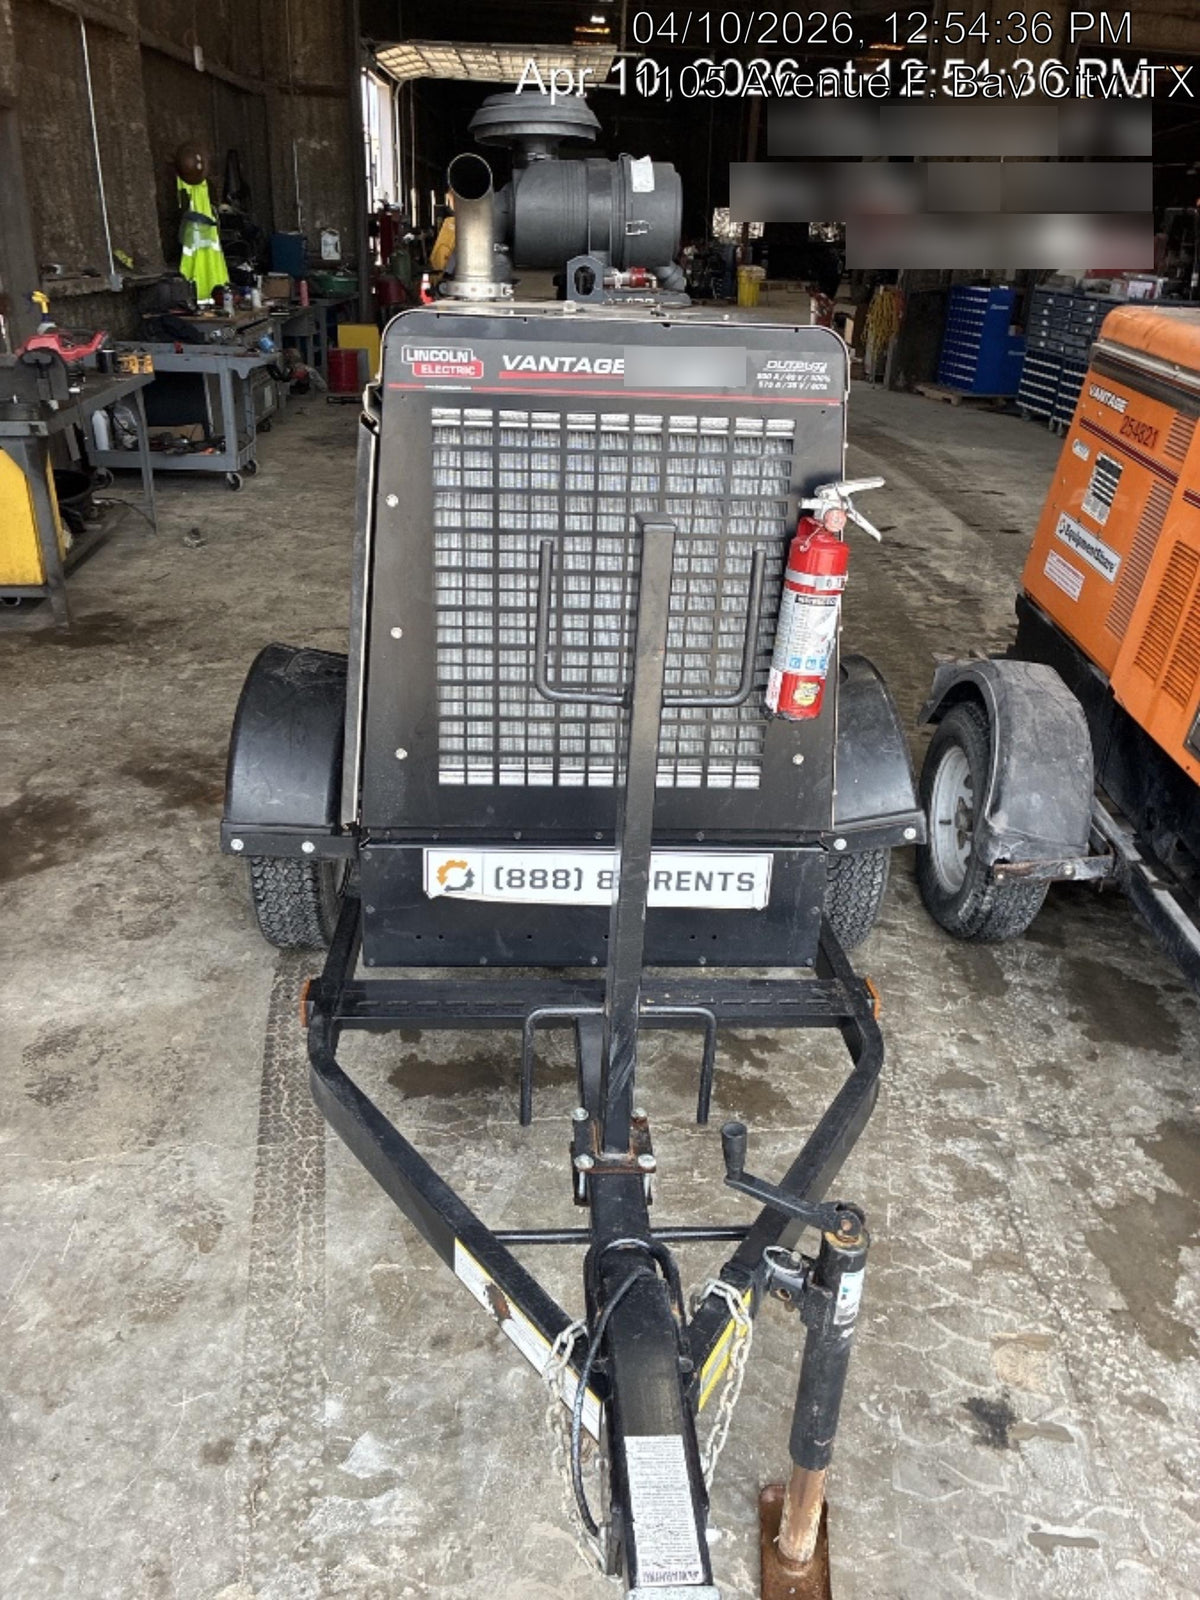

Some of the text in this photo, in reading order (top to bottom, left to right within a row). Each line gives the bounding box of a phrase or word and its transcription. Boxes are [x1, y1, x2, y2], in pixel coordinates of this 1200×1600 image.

[406, 349, 469, 363] LINCOLN
[503, 355, 624, 374] VANTAGE
[421, 364, 476, 376] ELECTRIC
[1088, 384, 1129, 413] VANTAGE
[494, 867, 583, 892] (888)
